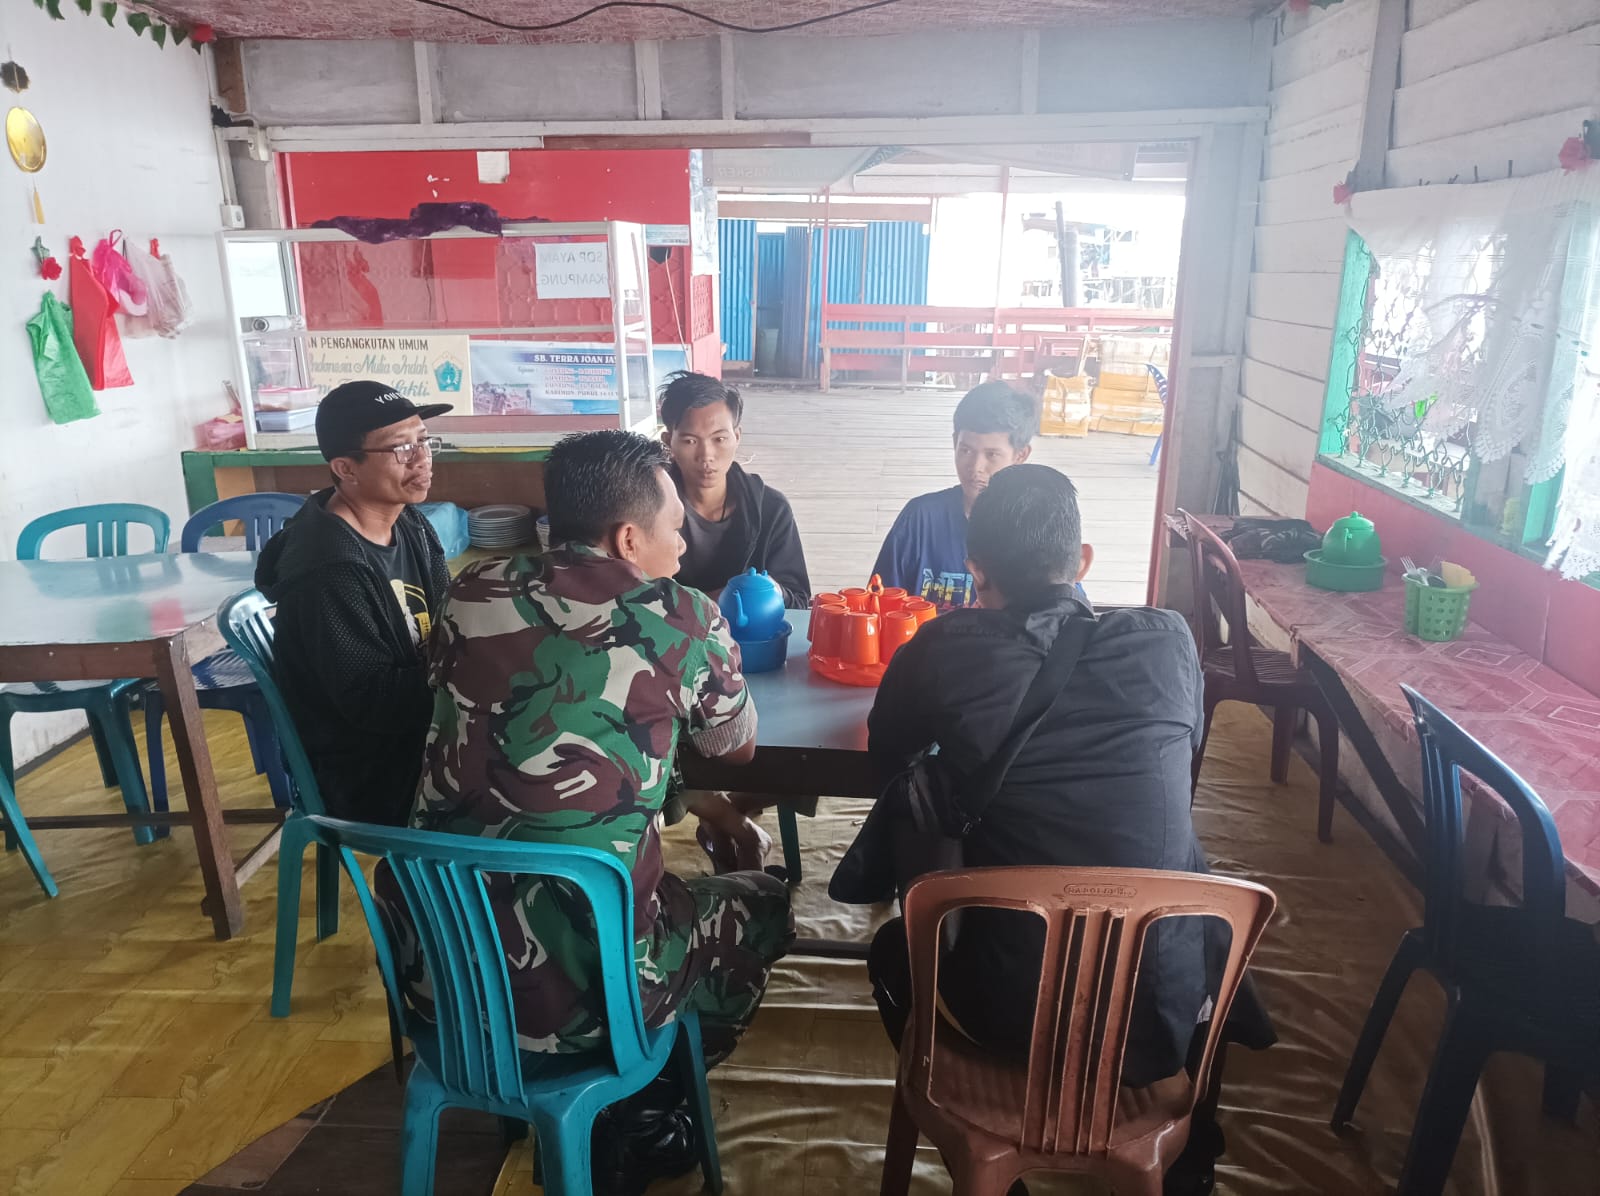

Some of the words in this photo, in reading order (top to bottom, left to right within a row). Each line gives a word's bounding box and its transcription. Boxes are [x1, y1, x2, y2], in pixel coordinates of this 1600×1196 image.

[321, 337, 395, 351] PENGANGKUTAN
[399, 339, 429, 351] UMUM
[534, 354, 548, 363] SB.
[550, 354, 580, 364] TERRA
[581, 355, 603, 364] JOAN
